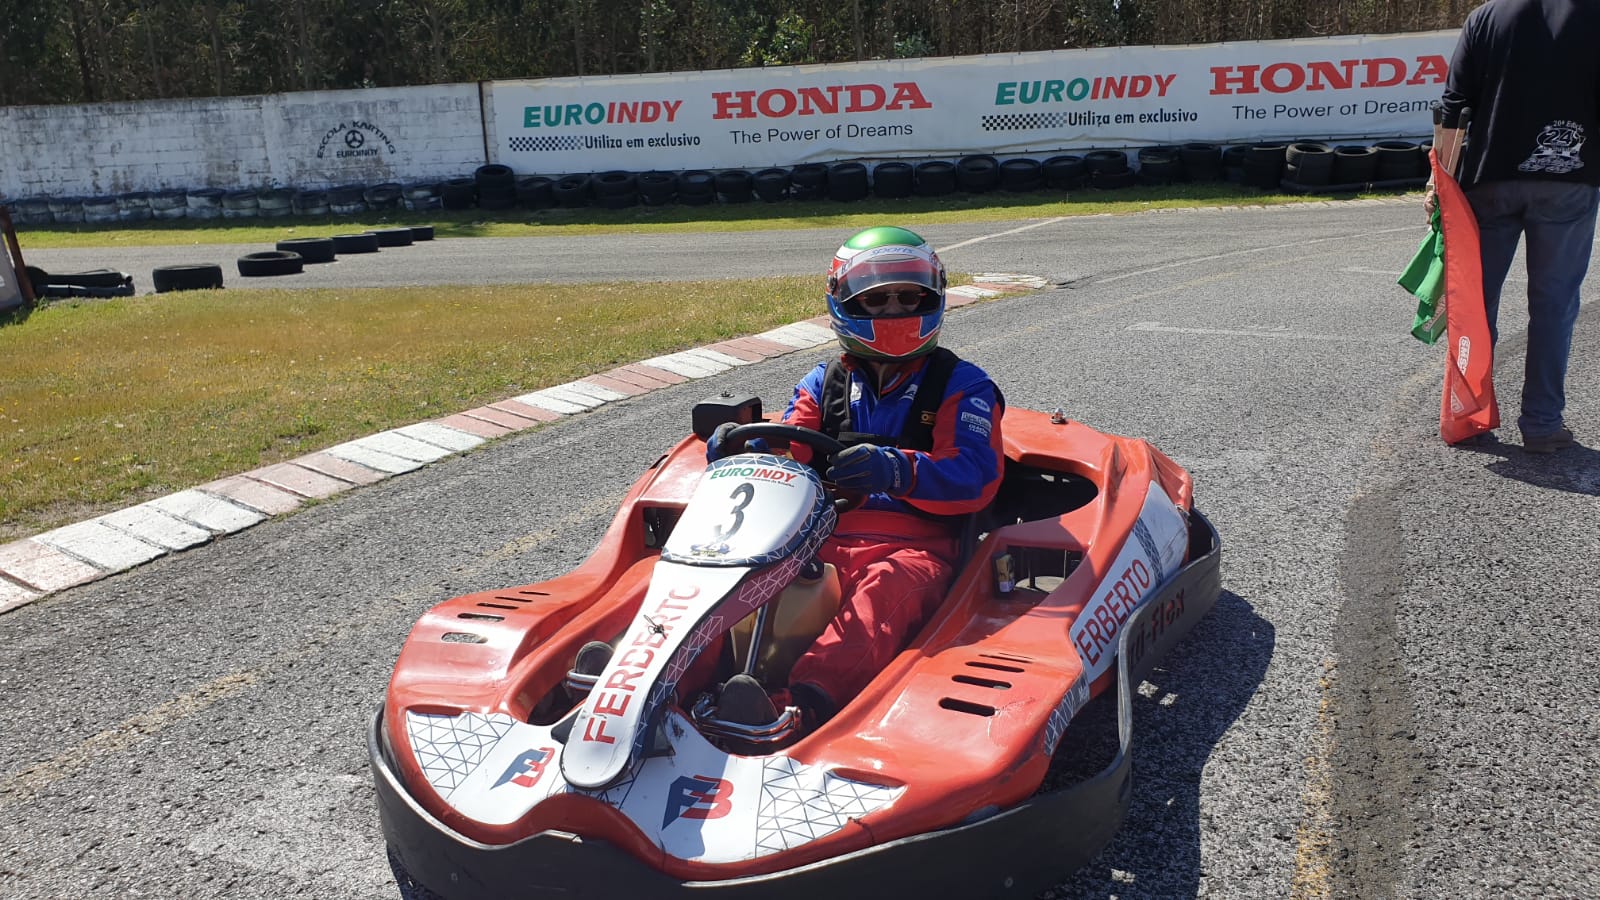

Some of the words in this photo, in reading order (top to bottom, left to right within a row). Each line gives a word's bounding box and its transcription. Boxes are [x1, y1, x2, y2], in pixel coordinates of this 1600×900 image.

[1209, 55, 1448, 96] HONDA
[711, 81, 933, 120] HONDA
[995, 73, 1177, 105] EUROINDY
[523, 99, 683, 128] EUROINDY
[1067, 111, 1111, 128] Utiliza
[1115, 113, 1134, 125] em
[1138, 108, 1198, 124] exclusivo
[1231, 104, 1266, 120] The
[1274, 103, 1329, 119] Power
[1331, 102, 1357, 117] of
[1365, 98, 1439, 114] Dreams
[317, 123, 346, 158] ESCOLA
[352, 121, 396, 154] KARTING
[584, 134, 624, 150] Utiliza
[626, 138, 645, 149] em
[647, 133, 701, 148] exclusivo
[730, 129, 761, 145] The
[768, 126, 819, 143] Power
[820, 124, 842, 140] of
[847, 121, 913, 139] Dreams
[1542, 129, 1573, 146] 24
[337, 149, 378, 158] EUROINDY
[710, 467, 798, 483] EUROINDY
[714, 481, 755, 542] 3
